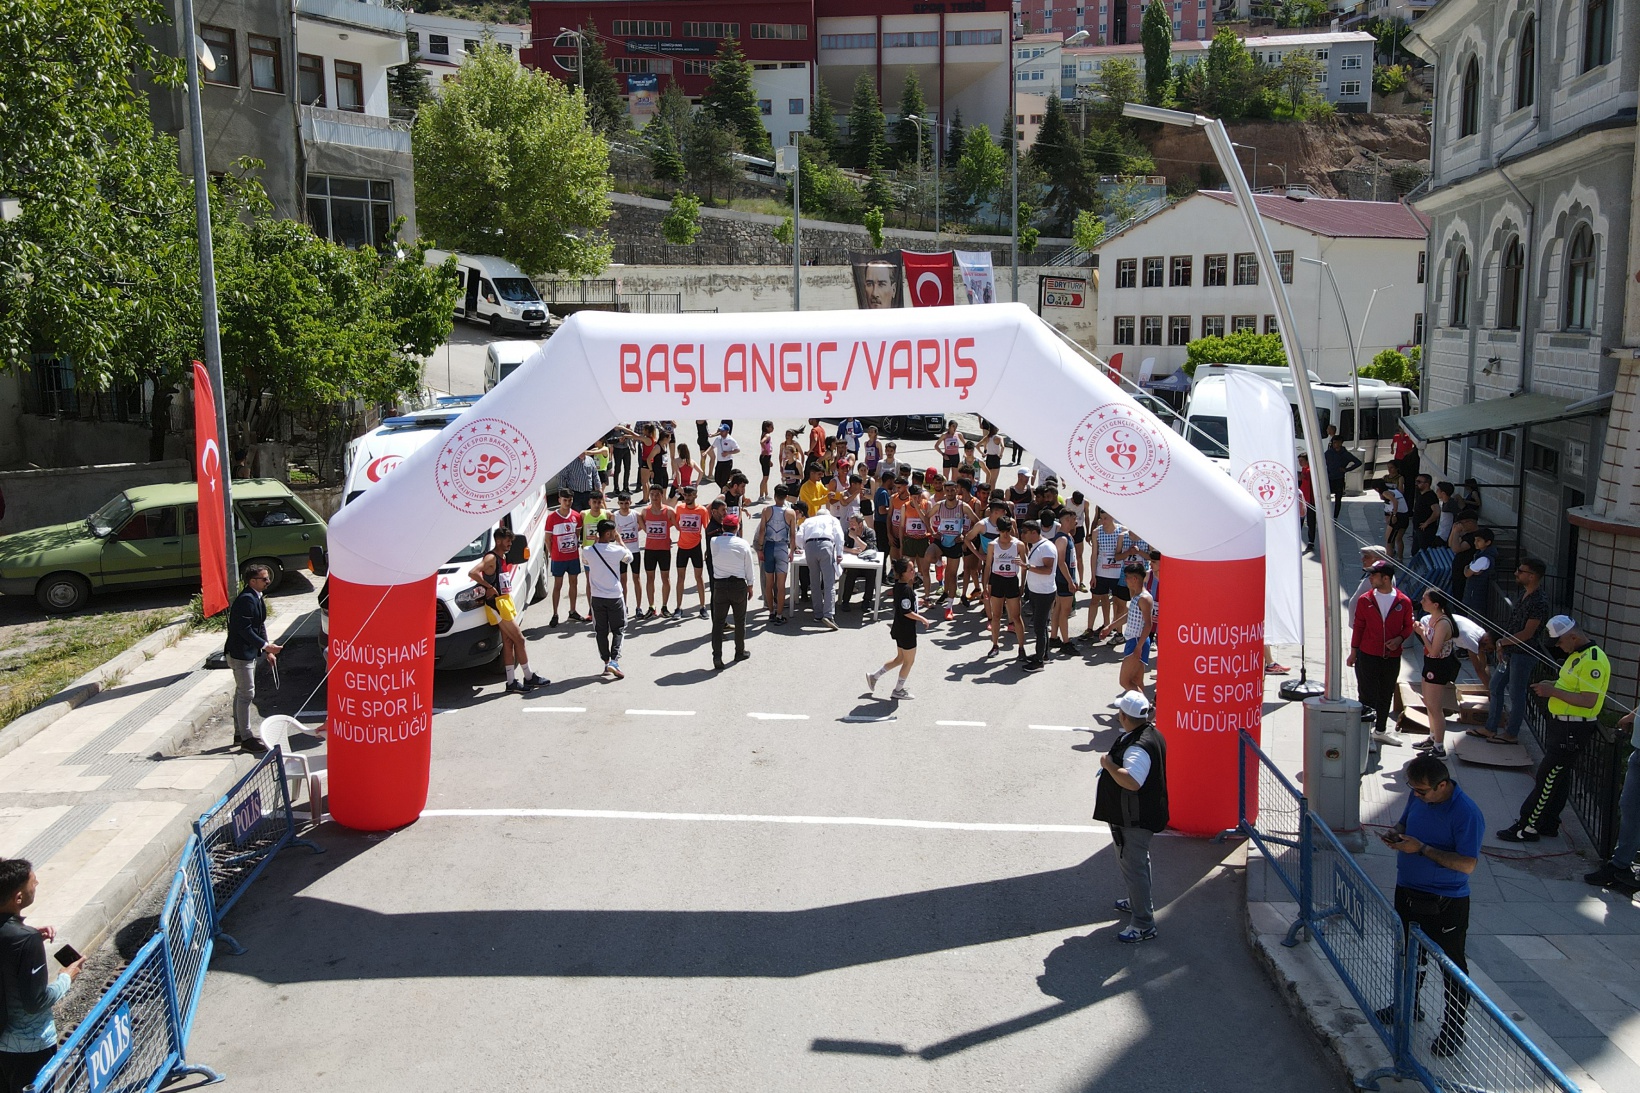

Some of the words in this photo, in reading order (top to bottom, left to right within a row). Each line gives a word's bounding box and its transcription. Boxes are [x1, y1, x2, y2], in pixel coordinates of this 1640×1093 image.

[619, 337, 978, 406] BAŞLANGIÇ/VARIŞ
[463, 442, 471, 450] VE
[471, 436, 488, 445] SPOR
[489, 437, 517, 461] BAKANLIĞI
[1143, 432, 1153, 448] SPOR
[998, 563, 1011, 571] 68
[332, 637, 428, 669] GÜMÜŞHANE
[1194, 651, 1260, 679] GENÇLİK
[344, 669, 416, 696] GENÇLİK
[1183, 682, 1206, 703] VE
[1212, 682, 1254, 704] SPOR
[1256, 676, 1262, 697] İL
[337, 694, 356, 717] VE
[361, 698, 408, 718] SPOR
[413, 691, 423, 711] İL
[333, 711, 428, 744] MÜDÜRLÜĞÜ
[234, 794, 261, 838] POLİS
[1335, 870, 1363, 930] POLİS
[90, 1013, 130, 1089] POLİS
